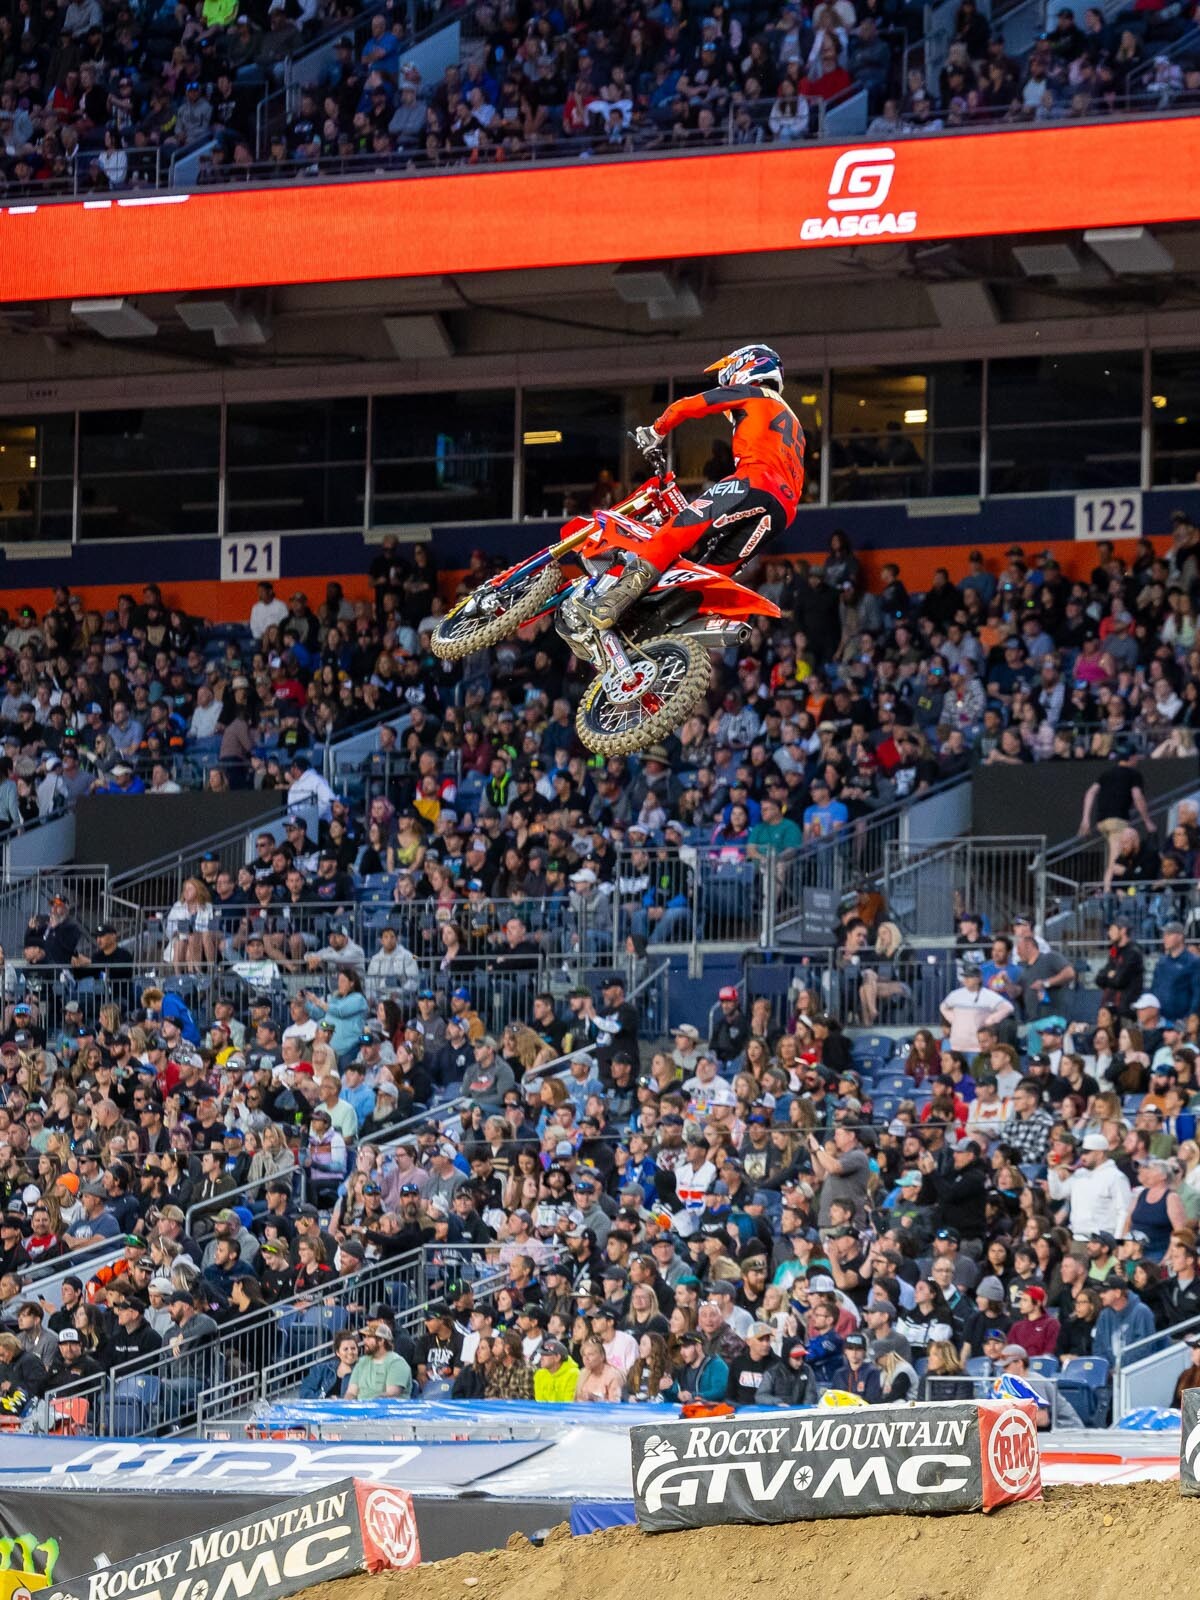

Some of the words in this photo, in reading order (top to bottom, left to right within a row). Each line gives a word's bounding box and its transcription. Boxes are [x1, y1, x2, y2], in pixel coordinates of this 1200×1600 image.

[800, 211, 918, 240] GASGAS
[1083, 498, 1136, 533] 122
[228, 541, 273, 574] 121
[683, 1425, 790, 1459] ROCKY
[793, 1419, 971, 1453] MOUNTAIN
[88, 1550, 182, 1600] ROCKY
[184, 1490, 350, 1573] MOUNTAIN
